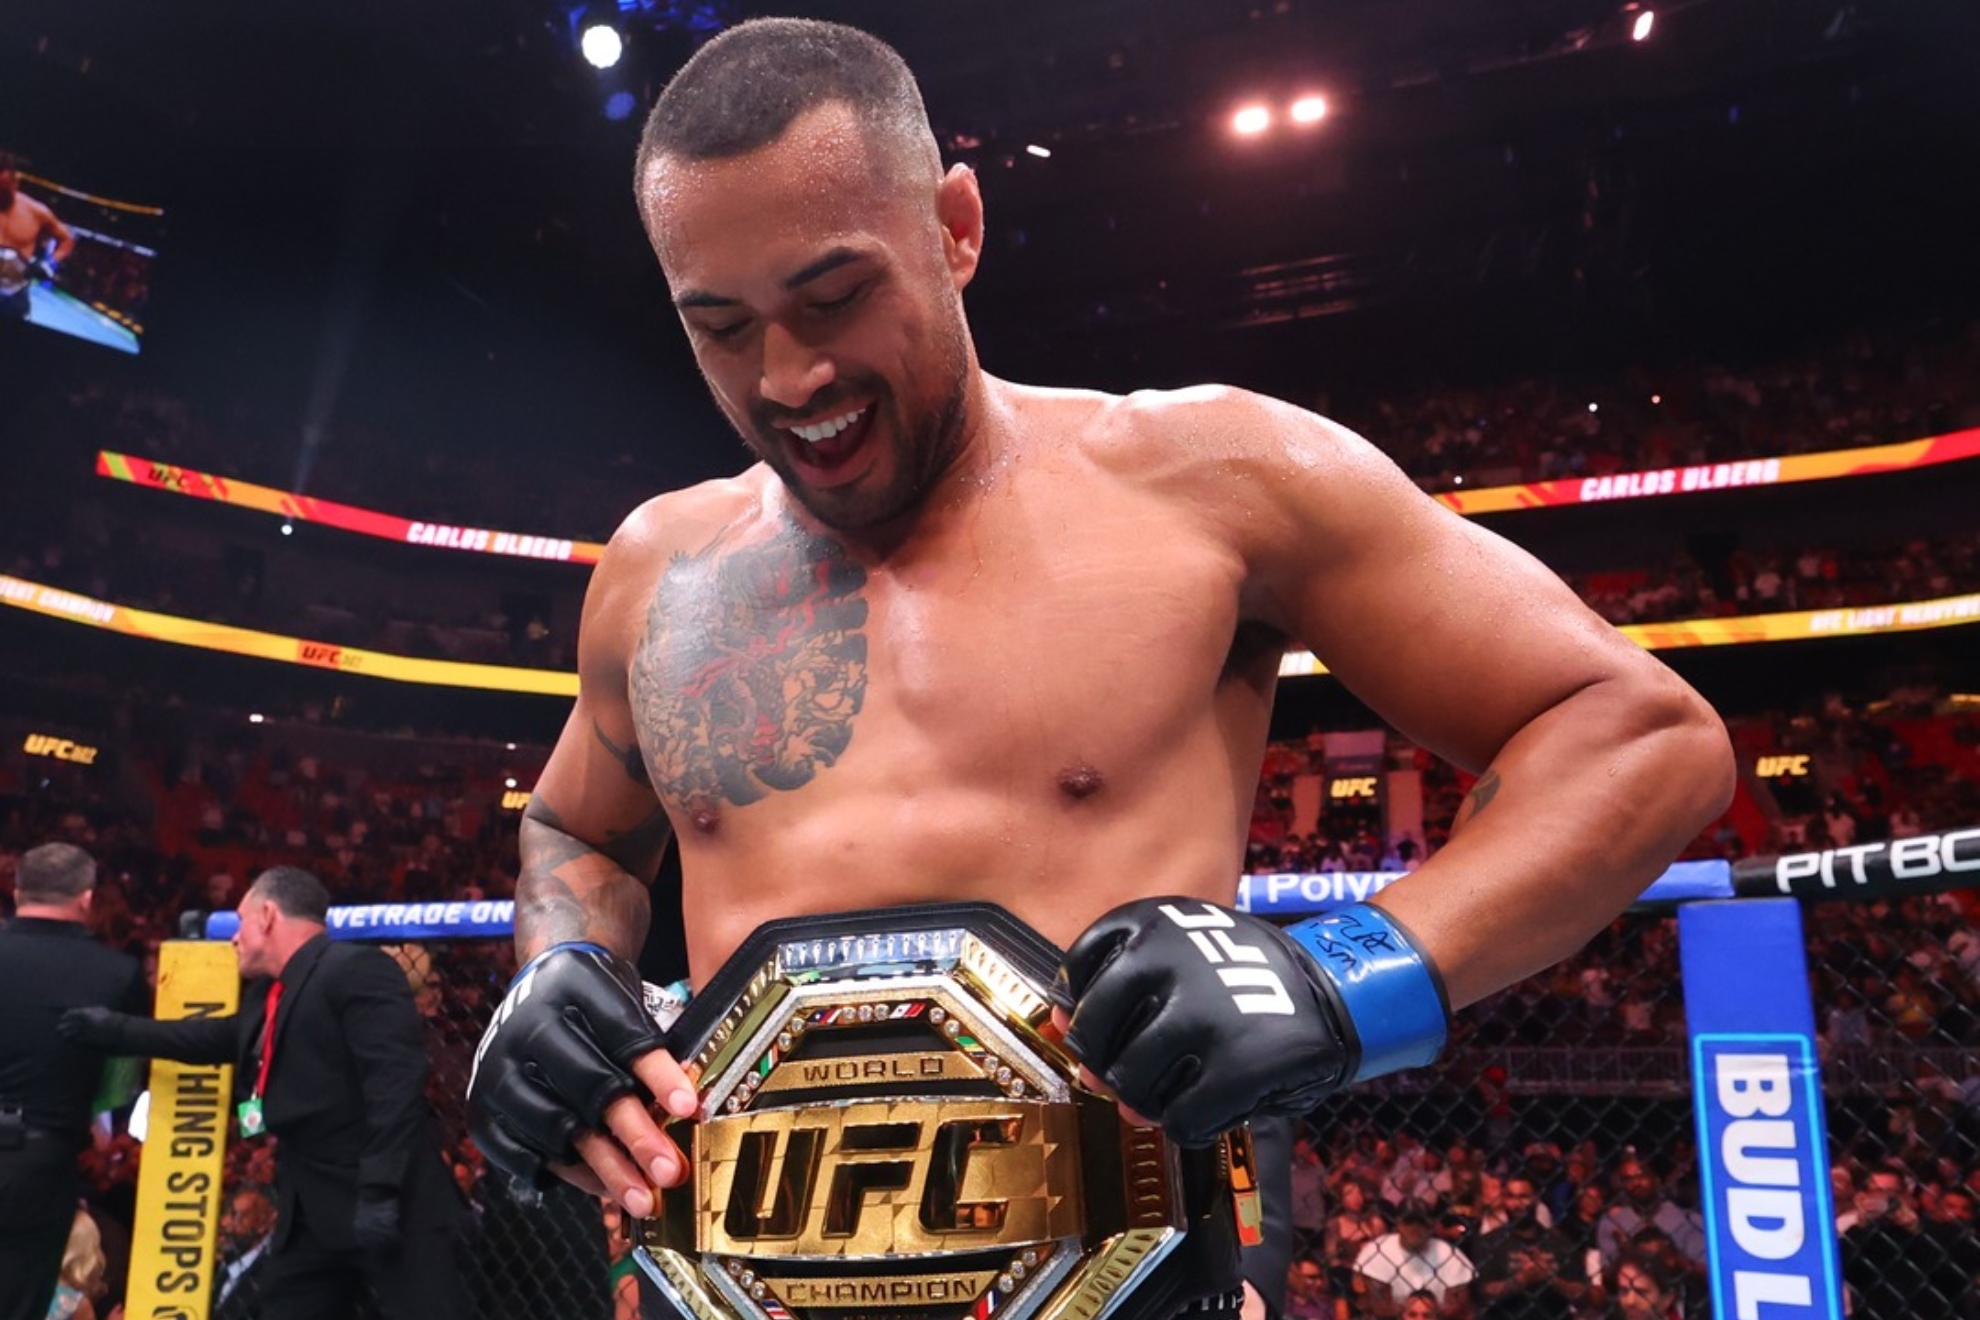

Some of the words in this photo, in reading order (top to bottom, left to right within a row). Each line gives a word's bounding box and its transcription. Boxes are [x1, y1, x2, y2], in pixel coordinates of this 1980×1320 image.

[1580, 469, 1676, 501] CARLOS
[1681, 458, 1781, 491] ULBERG
[406, 521, 490, 551] CARLOS
[493, 532, 573, 561] ULBERG
[38, 589, 116, 623] CHAMPION
[302, 646, 341, 664] UFC
[23, 733, 74, 760] UFC
[1756, 754, 1810, 777] UFC
[502, 790, 533, 810] UF
[1331, 777, 1377, 797] UFC
[327, 902, 466, 929] VETRADE
[1158, 904, 1296, 1015] UFC
[169, 1002, 227, 1158] NHING
[803, 1056, 944, 1082] WORLD
[1714, 1053, 1806, 1261] BUD
[723, 1113, 1024, 1240] UFC
[155, 1171, 211, 1294] STOPS
[786, 1278, 976, 1302] CHAMPION
